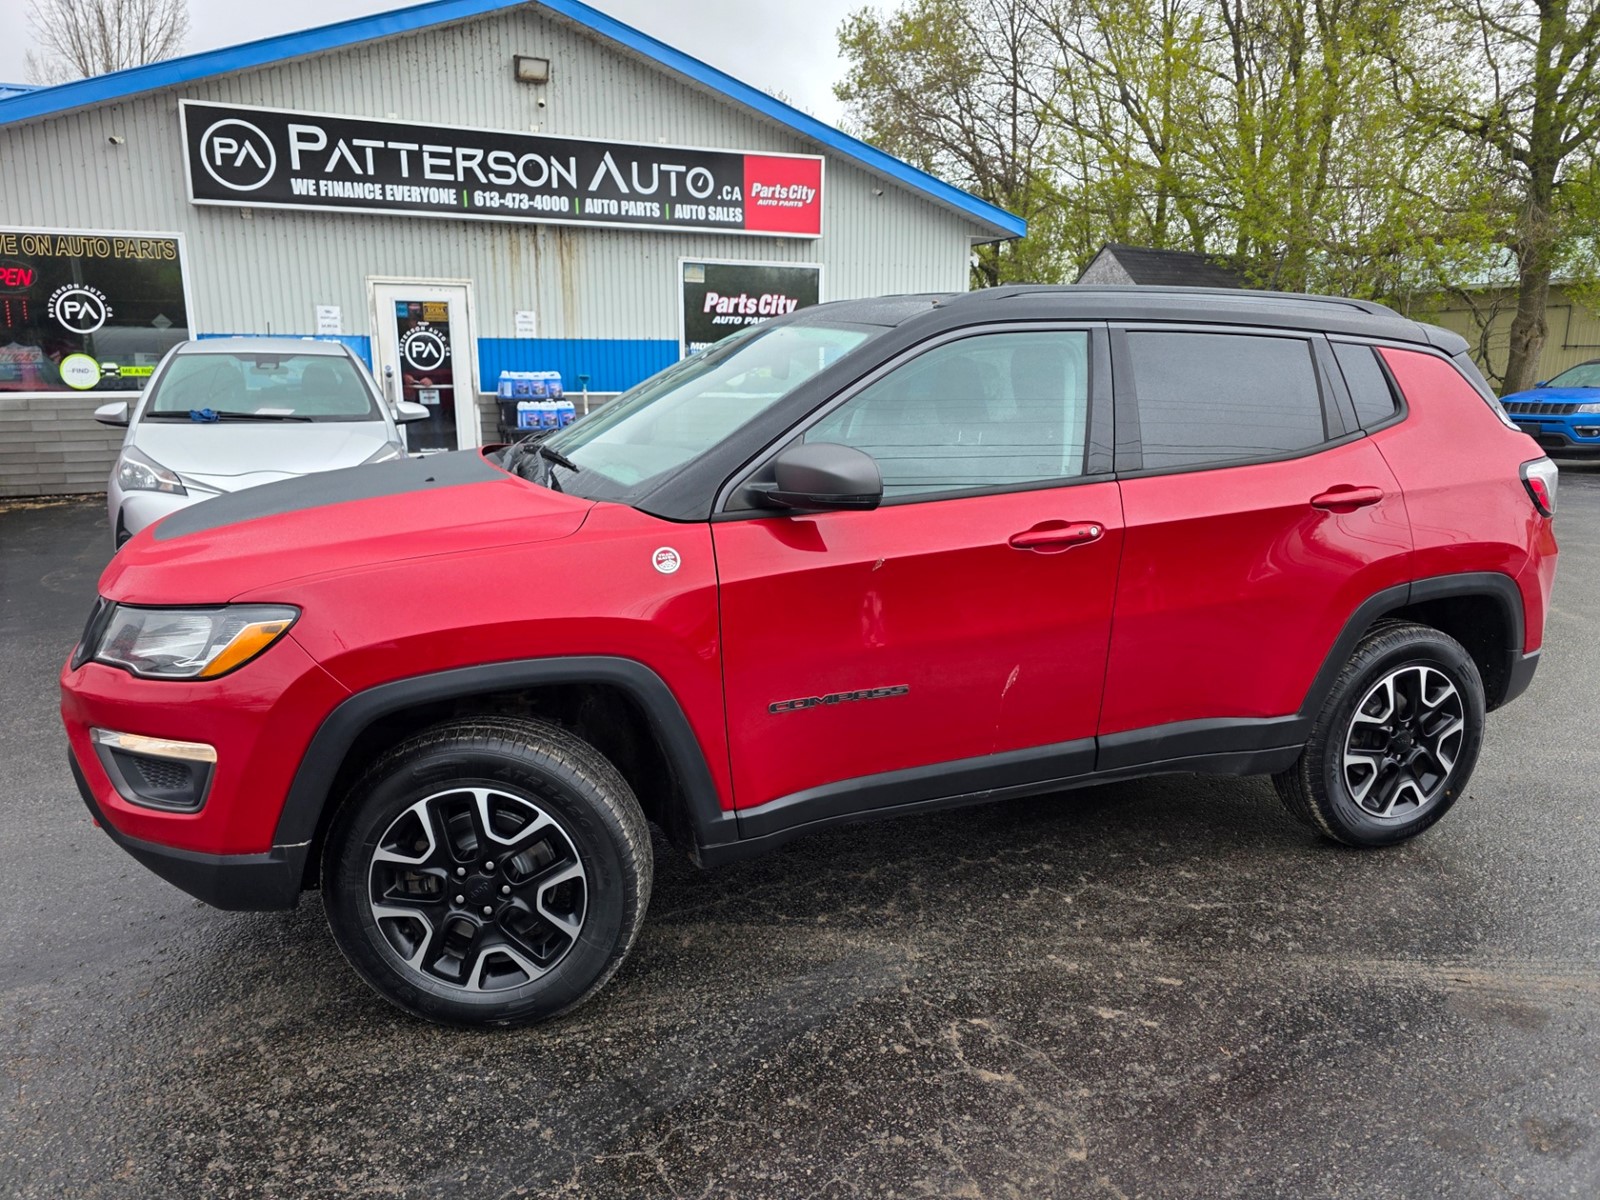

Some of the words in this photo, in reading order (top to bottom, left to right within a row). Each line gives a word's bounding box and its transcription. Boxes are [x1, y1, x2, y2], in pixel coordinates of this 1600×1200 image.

[213, 136, 266, 169] PA
[288, 123, 577, 189] PATTERSON
[291, 178, 317, 196] WE
[319, 180, 383, 200] FINANCE
[385, 185, 457, 205] EVERYONE
[474, 190, 569, 212] 613-473-4000
[584, 197, 618, 215] AUTO
[621, 200, 661, 218] PARTS
[674, 203, 706, 220] AUTO
[708, 205, 743, 222] SALES
[779, 200, 803, 208] PARTS
[21, 235, 52, 256] ON
[56, 235, 110, 258] AUTO
[113, 238, 177, 260] PARTS
[47, 283, 80, 318] PATTERSON
[83, 285, 106, 301] AUTO
[63, 301, 99, 320] PA
[712, 316, 742, 325] AUTO
[411, 341, 440, 358] PA
[768, 684, 909, 714] COMPASS
